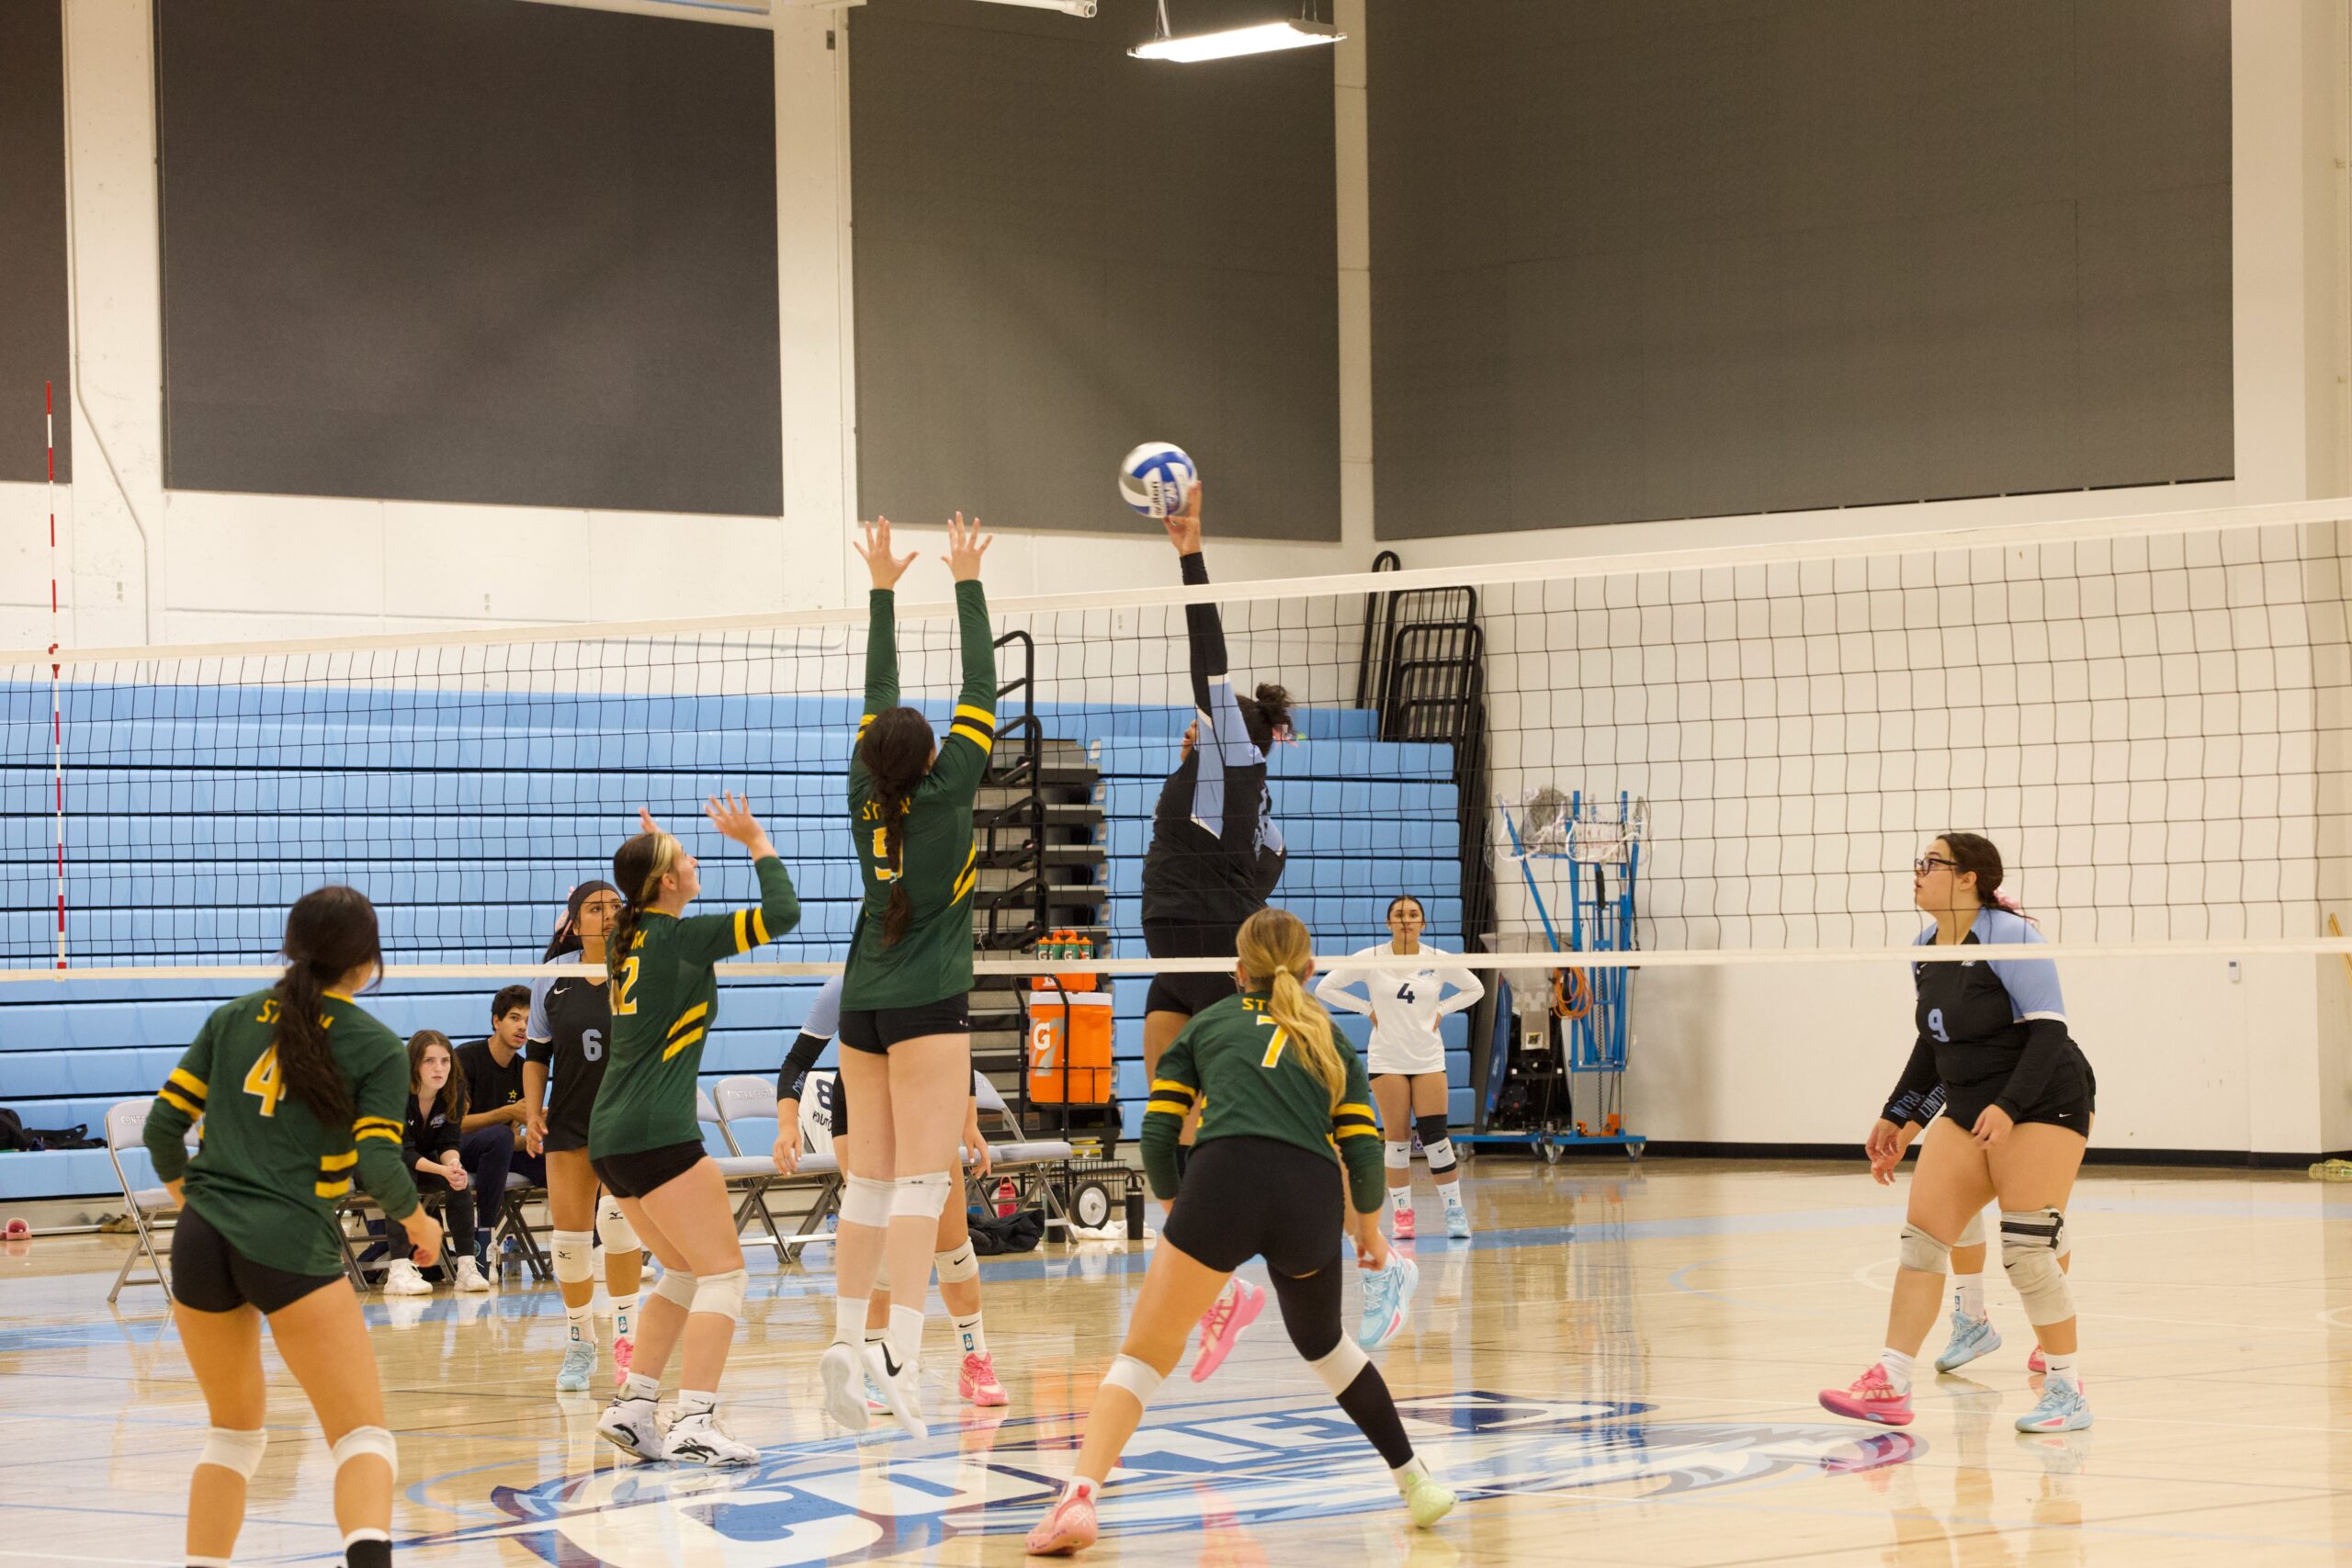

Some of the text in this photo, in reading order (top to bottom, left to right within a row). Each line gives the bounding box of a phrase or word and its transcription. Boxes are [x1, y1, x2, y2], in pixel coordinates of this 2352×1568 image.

[1396, 983, 1416, 1004] 4
[1034, 1022, 1050, 1051] G
[1256, 1014, 1290, 1068] 7
[1928, 1008, 1950, 1043] 9
[582, 1028, 603, 1062] 6
[243, 1041, 287, 1117] 4
[1918, 1083, 1946, 1119] CONTR
